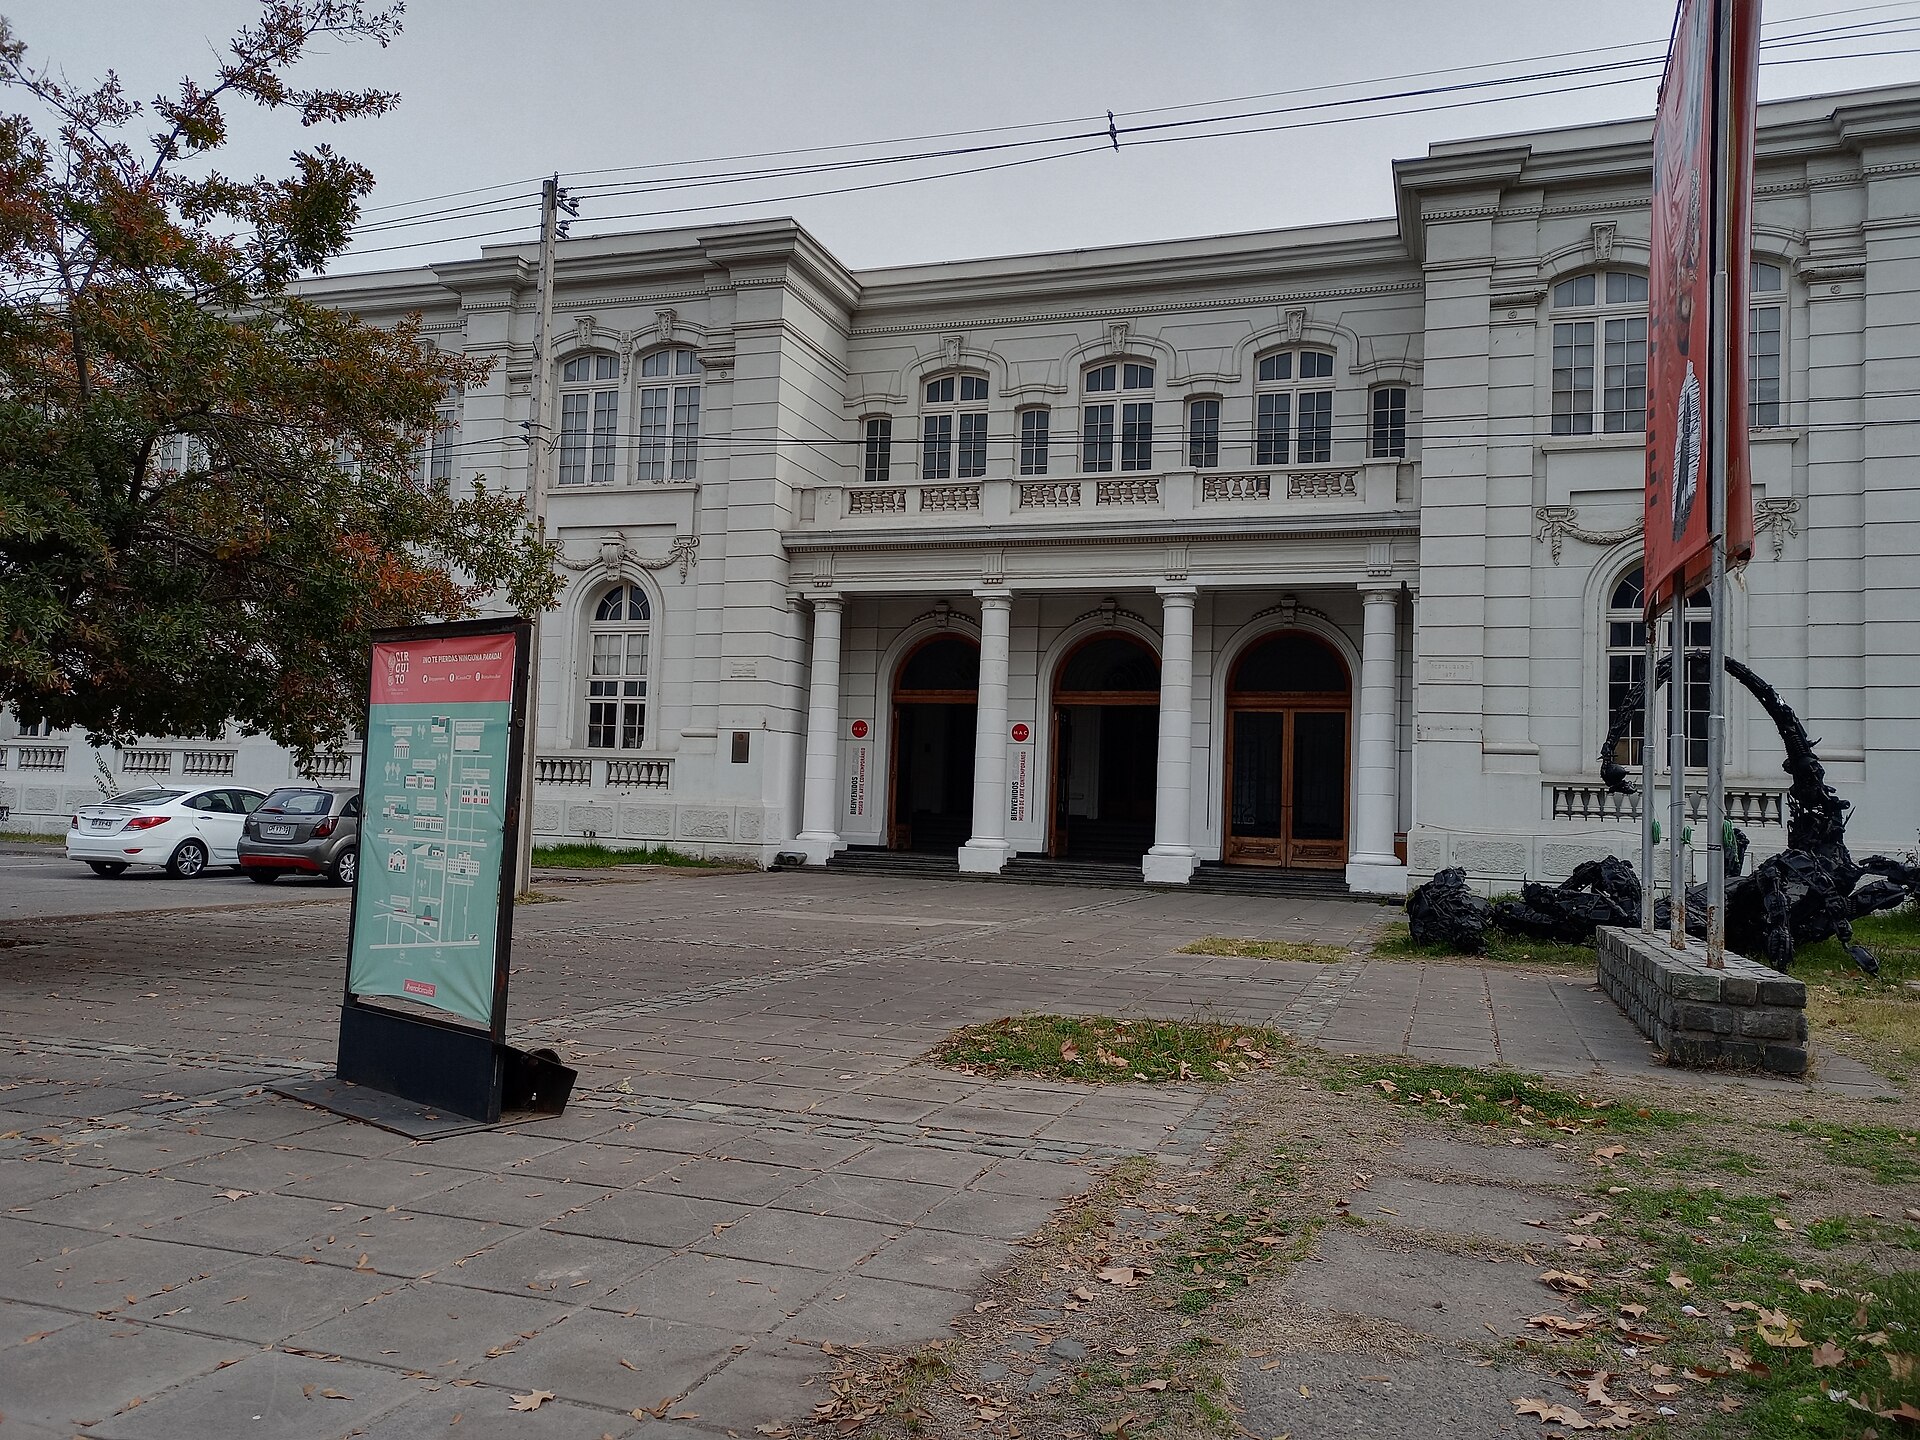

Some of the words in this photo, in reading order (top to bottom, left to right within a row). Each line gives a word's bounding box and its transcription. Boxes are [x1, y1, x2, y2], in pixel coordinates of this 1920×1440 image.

[395, 651, 409, 662] CIR
[432, 655, 438, 663] TE
[438, 655, 458, 663] PIERDAS
[458, 653, 482, 662] NINGUNA
[395, 662, 409, 673] CUI
[395, 674, 405, 684] TO
[850, 776, 858, 815] BIENVENIDOS
[1010, 781, 1019, 821] BIENVENIDOS
